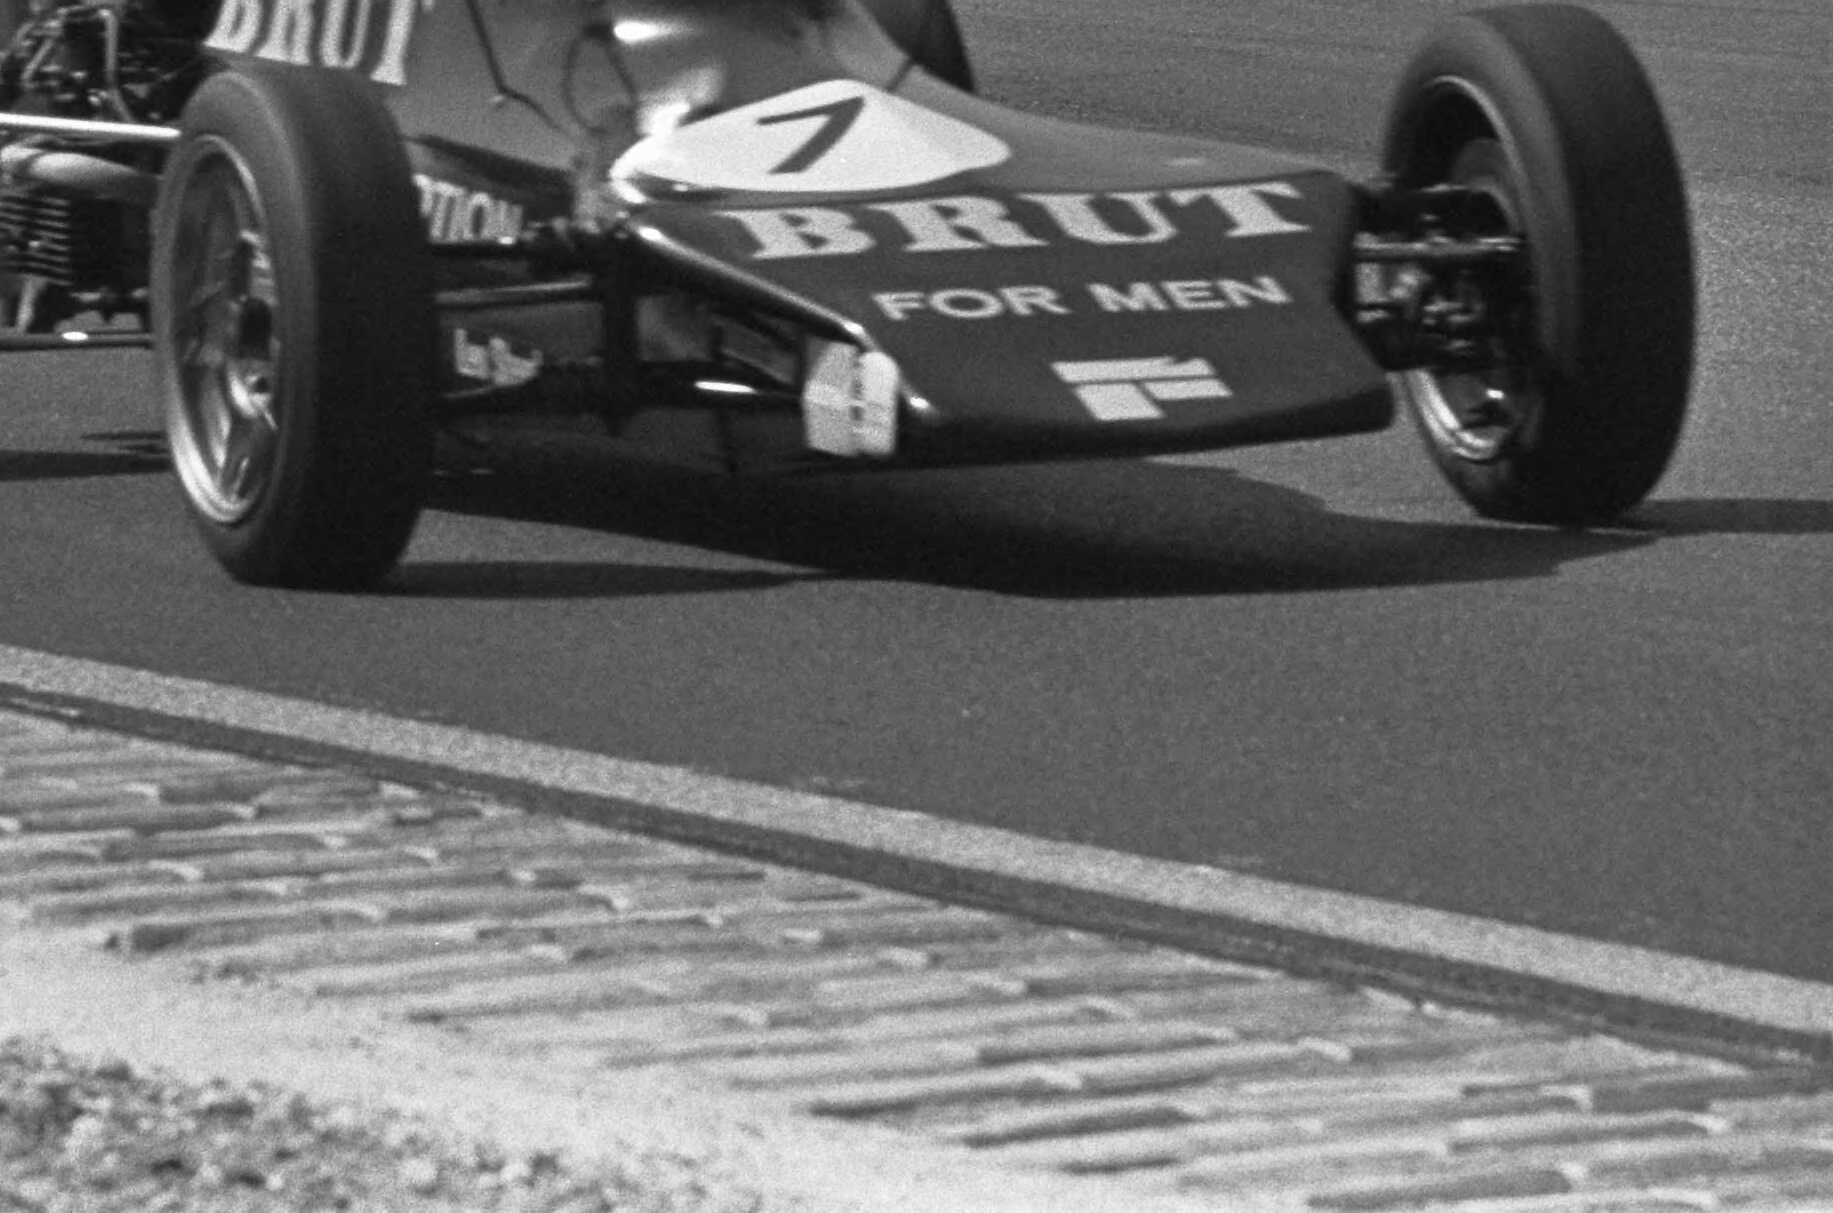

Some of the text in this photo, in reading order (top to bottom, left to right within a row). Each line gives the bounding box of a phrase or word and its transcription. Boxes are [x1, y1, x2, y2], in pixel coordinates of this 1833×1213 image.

[756, 96, 865, 175] 7
[717, 181, 1312, 260] BRUT
[872, 275, 1293, 322] FOR MEN
